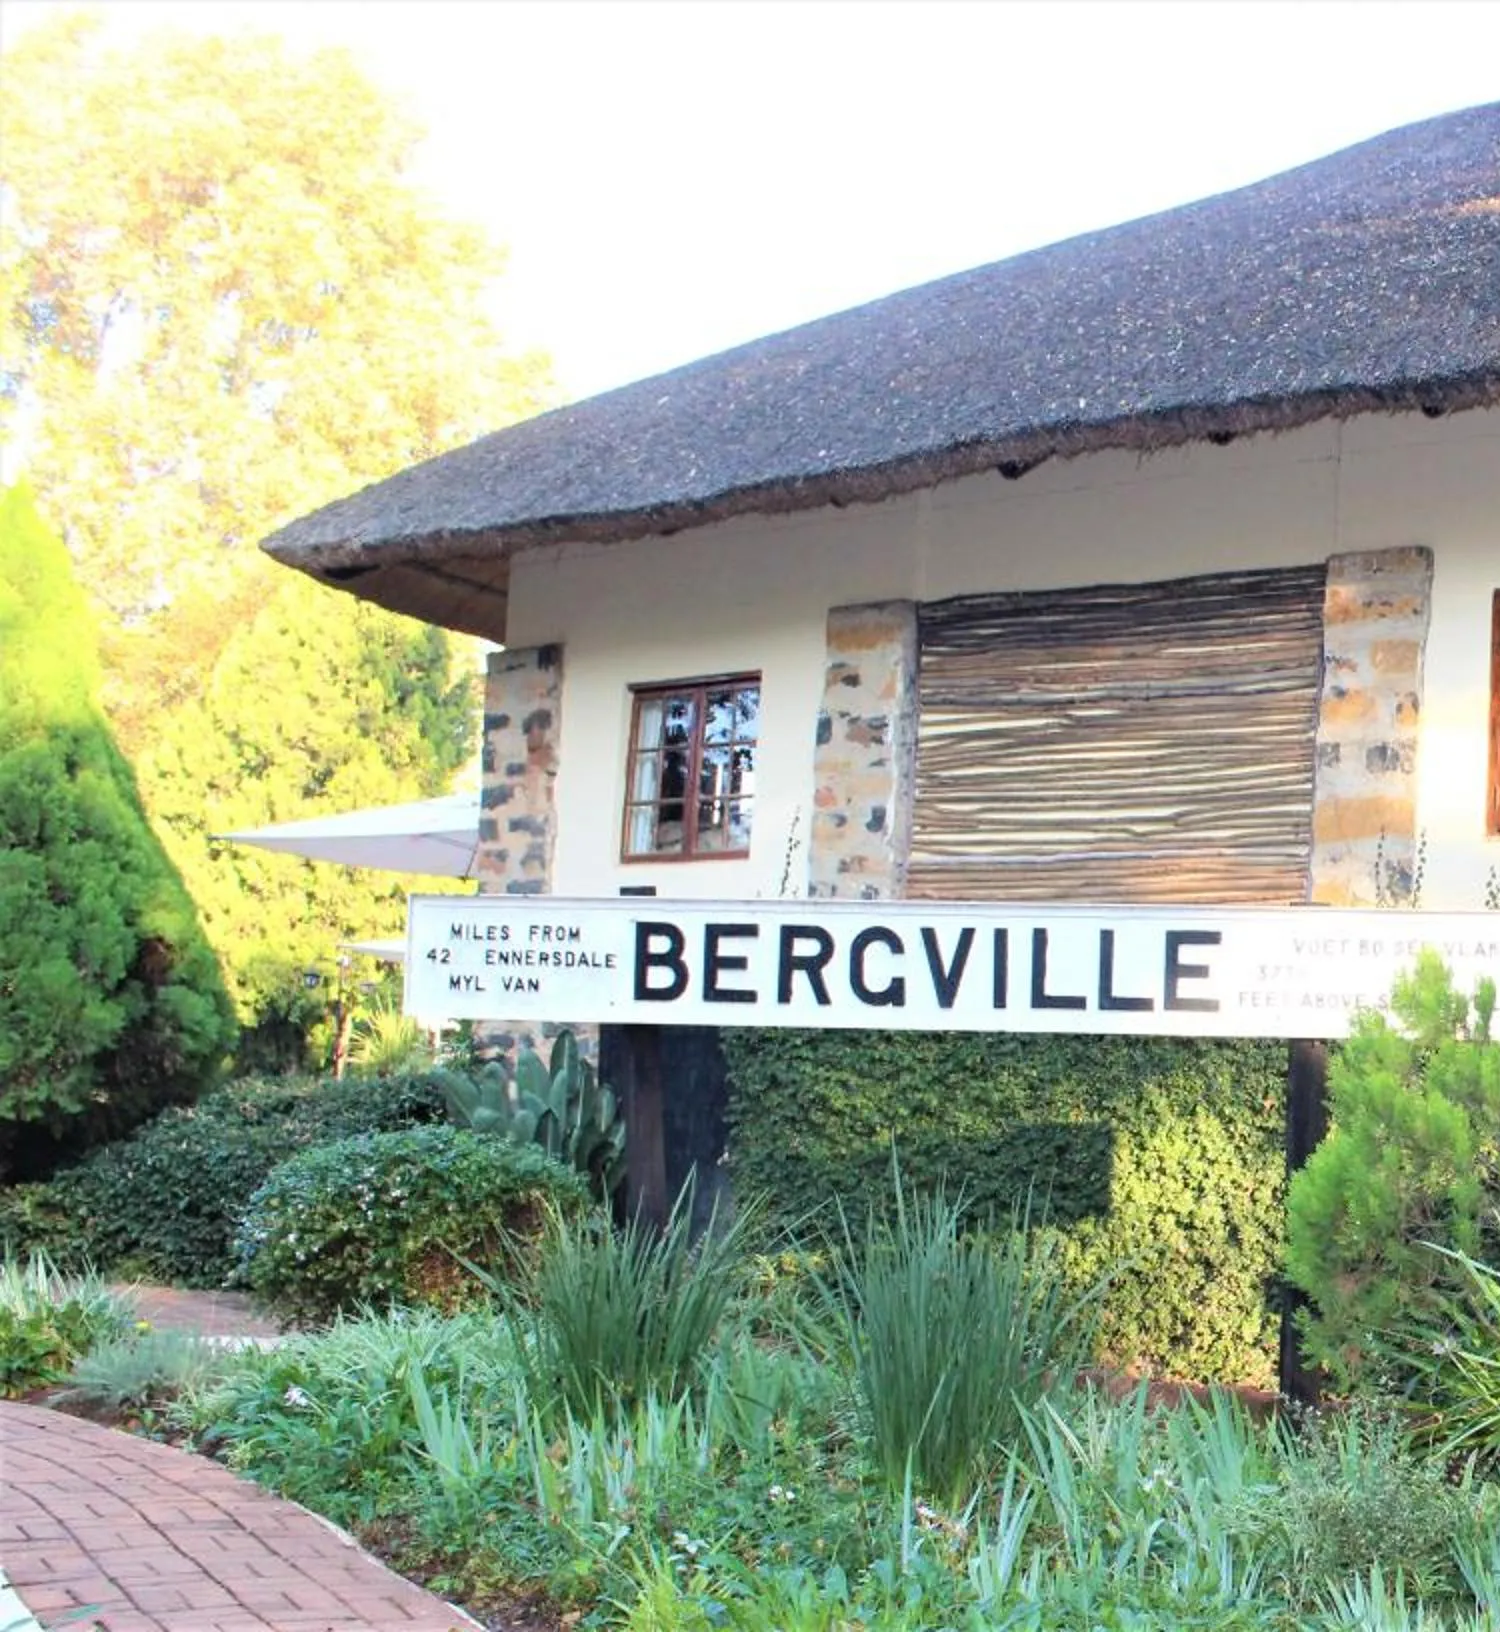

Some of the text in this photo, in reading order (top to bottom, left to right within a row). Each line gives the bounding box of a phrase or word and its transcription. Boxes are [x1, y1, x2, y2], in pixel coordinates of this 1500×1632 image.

[450, 923, 581, 943] MILES FROM
[426, 948, 617, 970] 42 ENNERSDALE
[633, 921, 1223, 1012] BERGVILLE
[449, 975, 540, 993] MYL VAN
